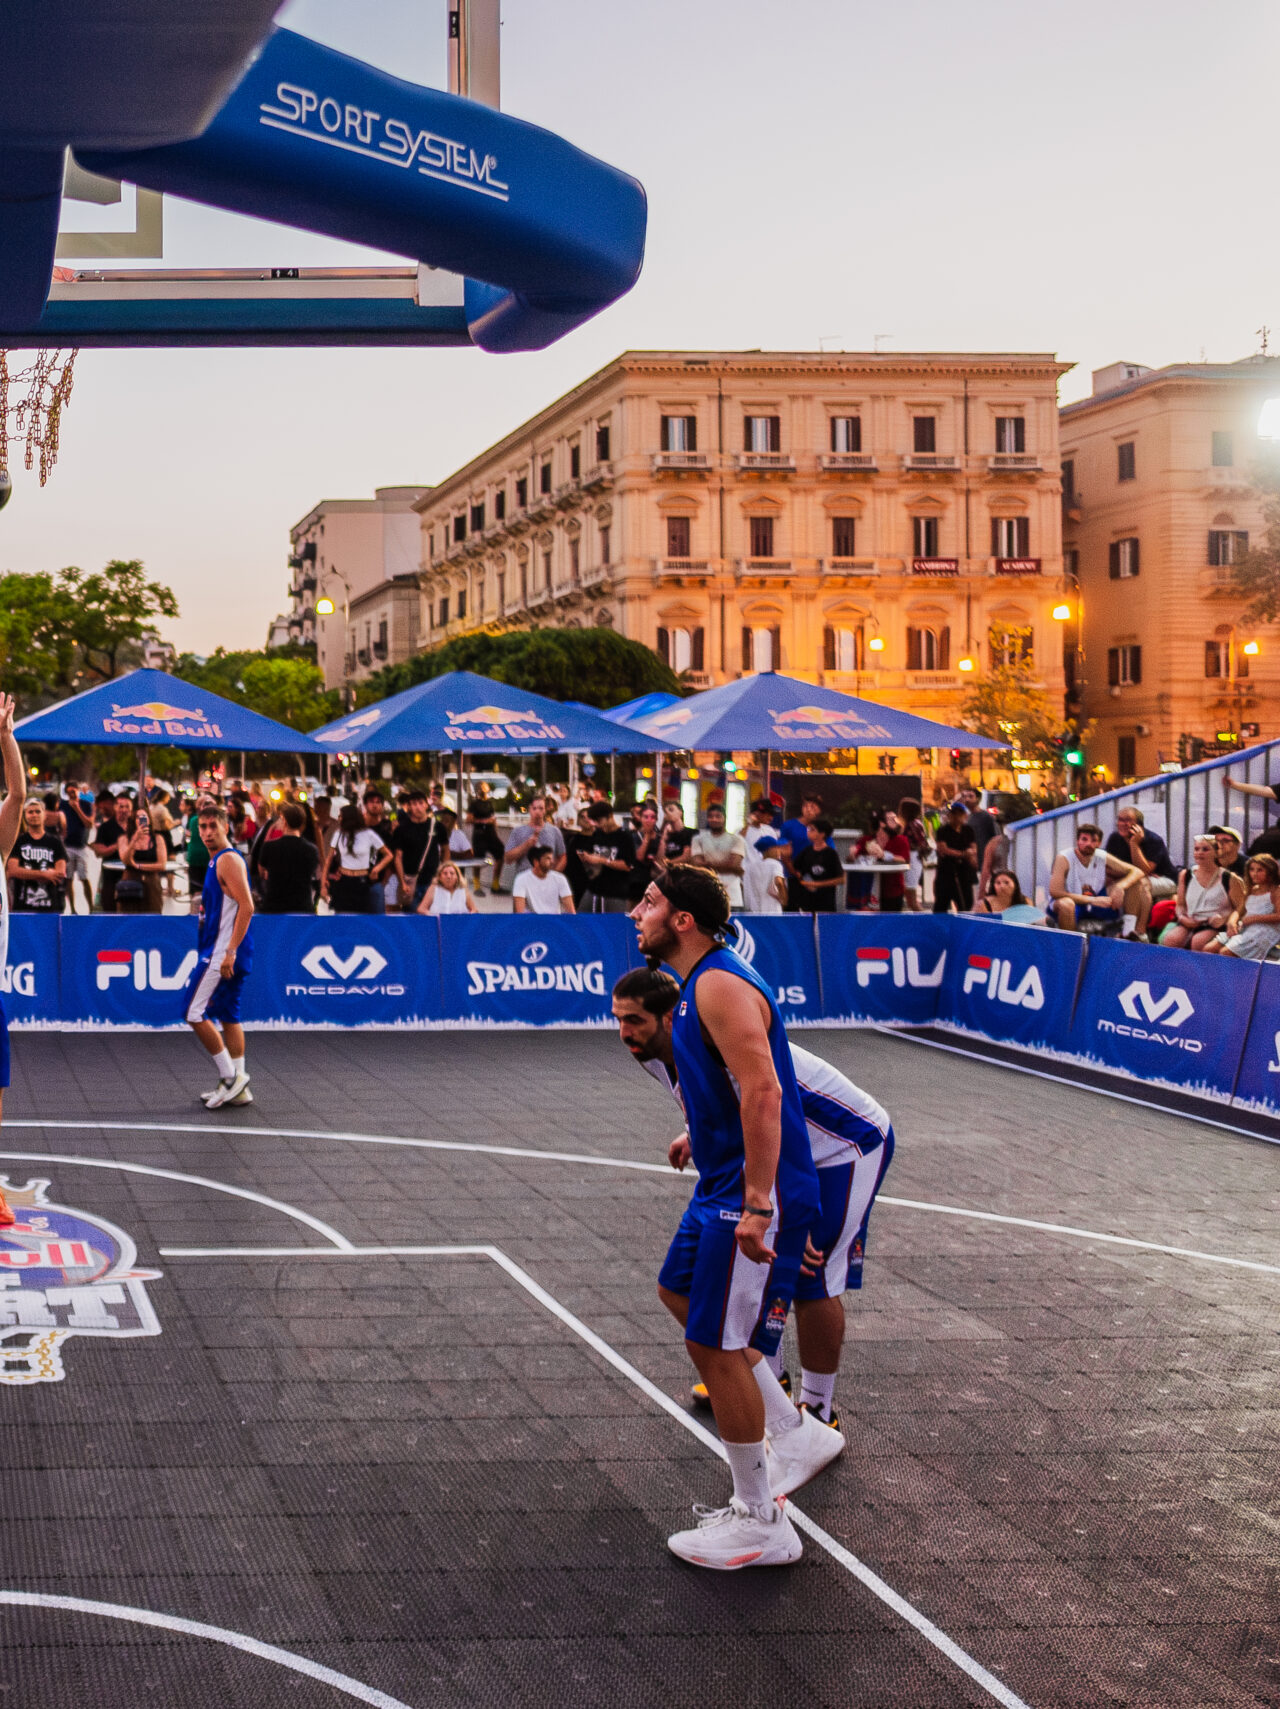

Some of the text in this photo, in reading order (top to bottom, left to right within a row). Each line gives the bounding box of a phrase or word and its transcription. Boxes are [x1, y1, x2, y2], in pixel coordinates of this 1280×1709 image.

[260, 82, 381, 144] SPORT
[103, 719, 223, 739] Red Bull
[443, 723, 566, 741] Red Bull
[771, 724, 893, 740] Red Bull
[467, 960, 607, 995] SPALDING
[963, 954, 1045, 1011] FILA
